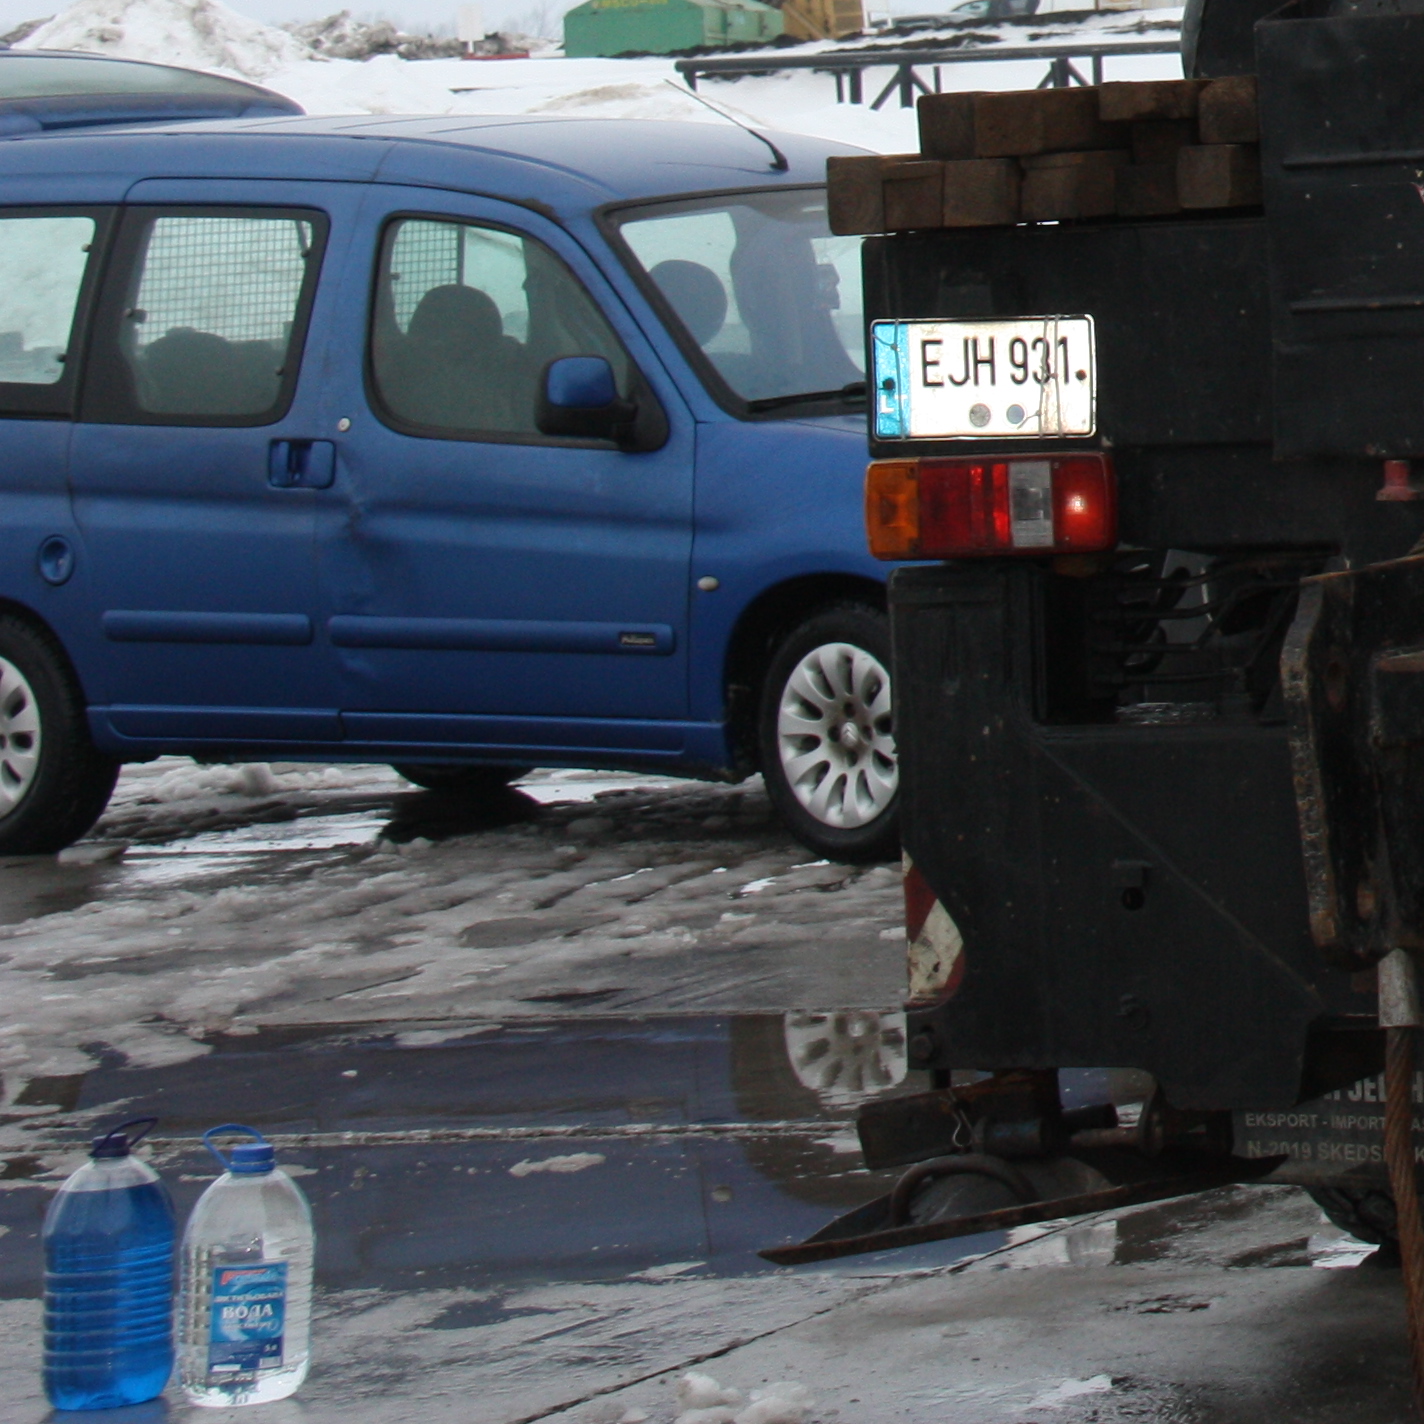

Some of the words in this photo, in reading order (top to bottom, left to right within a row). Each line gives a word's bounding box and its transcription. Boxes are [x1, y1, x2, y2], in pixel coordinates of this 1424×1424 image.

[920, 336, 997, 388] EJH
[1009, 336, 1070, 387] 931
[1245, 1113, 1318, 1128] EKSPORT
[1331, 1115, 1387, 1130] IMPORT
[222, 1303, 273, 1319] ВОДА
